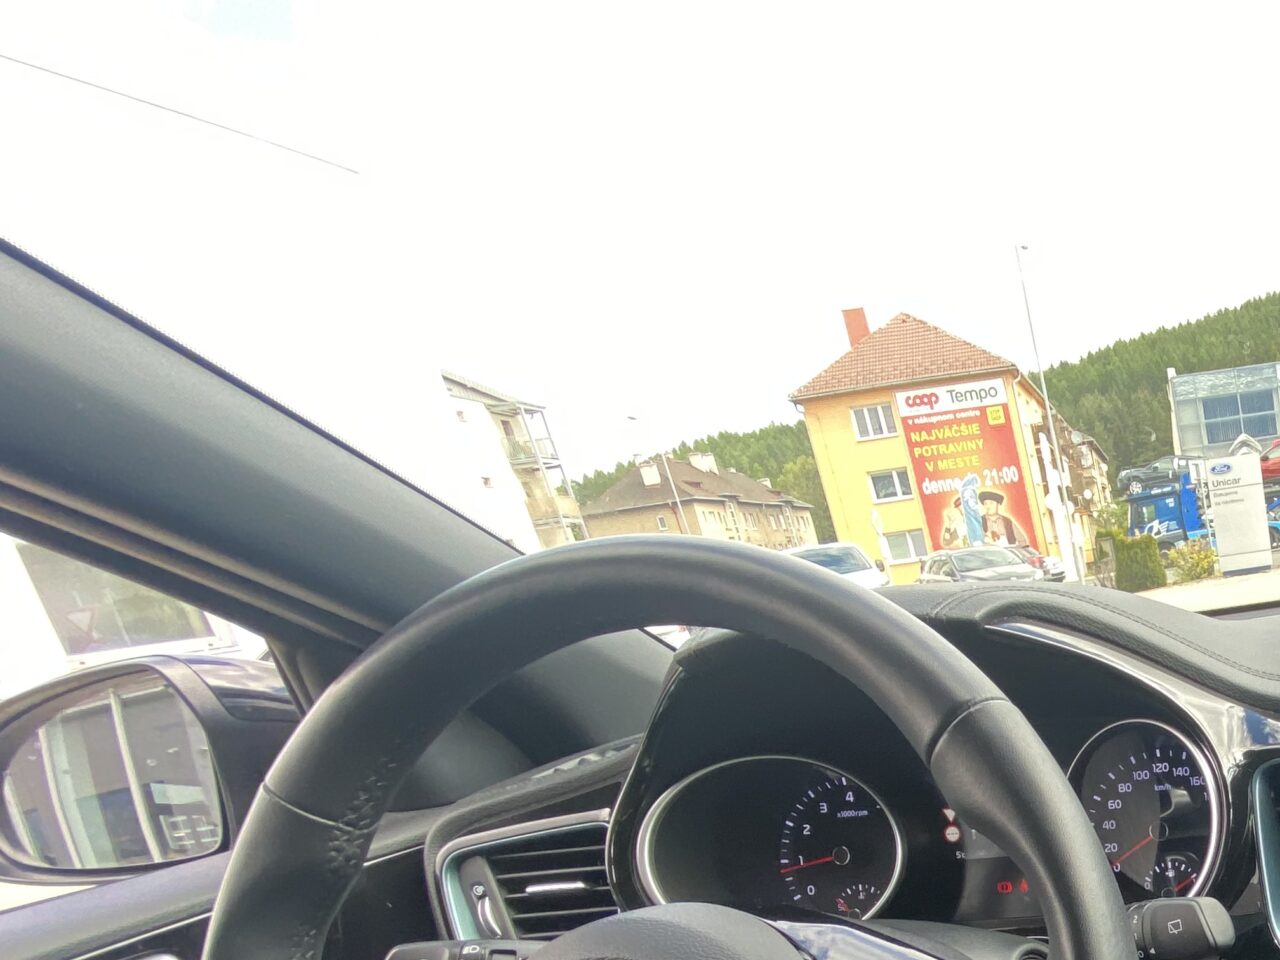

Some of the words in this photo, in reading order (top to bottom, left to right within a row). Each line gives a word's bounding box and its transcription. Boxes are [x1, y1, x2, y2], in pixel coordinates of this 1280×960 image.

[946, 386, 998, 403] Tempo
[910, 423, 982, 443] NAJVÄČŠIE
[913, 439, 984, 458] POTRAVINY
[925, 461, 934, 472] V
[937, 456, 980, 470] MESTE
[983, 465, 1019, 486] 21:00
[1212, 477, 1241, 488] Unicar
[1152, 763, 1169, 774] 120
[1172, 766, 1190, 778] 140
[1133, 771, 1150, 782] 100
[1118, 783, 1132, 793] 80
[1154, 782, 1172, 792] km/h
[845, 791, 854, 802] 4
[819, 802, 828, 813] 3
[1107, 800, 1122, 809] 60
[802, 824, 811, 835] 2
[1102, 820, 1116, 830] 40
[1104, 843, 1118, 853] 20
[1113, 863, 1121, 873] 0
[807, 885, 815, 895] 0
[1132, 915, 1138, 924] 2
